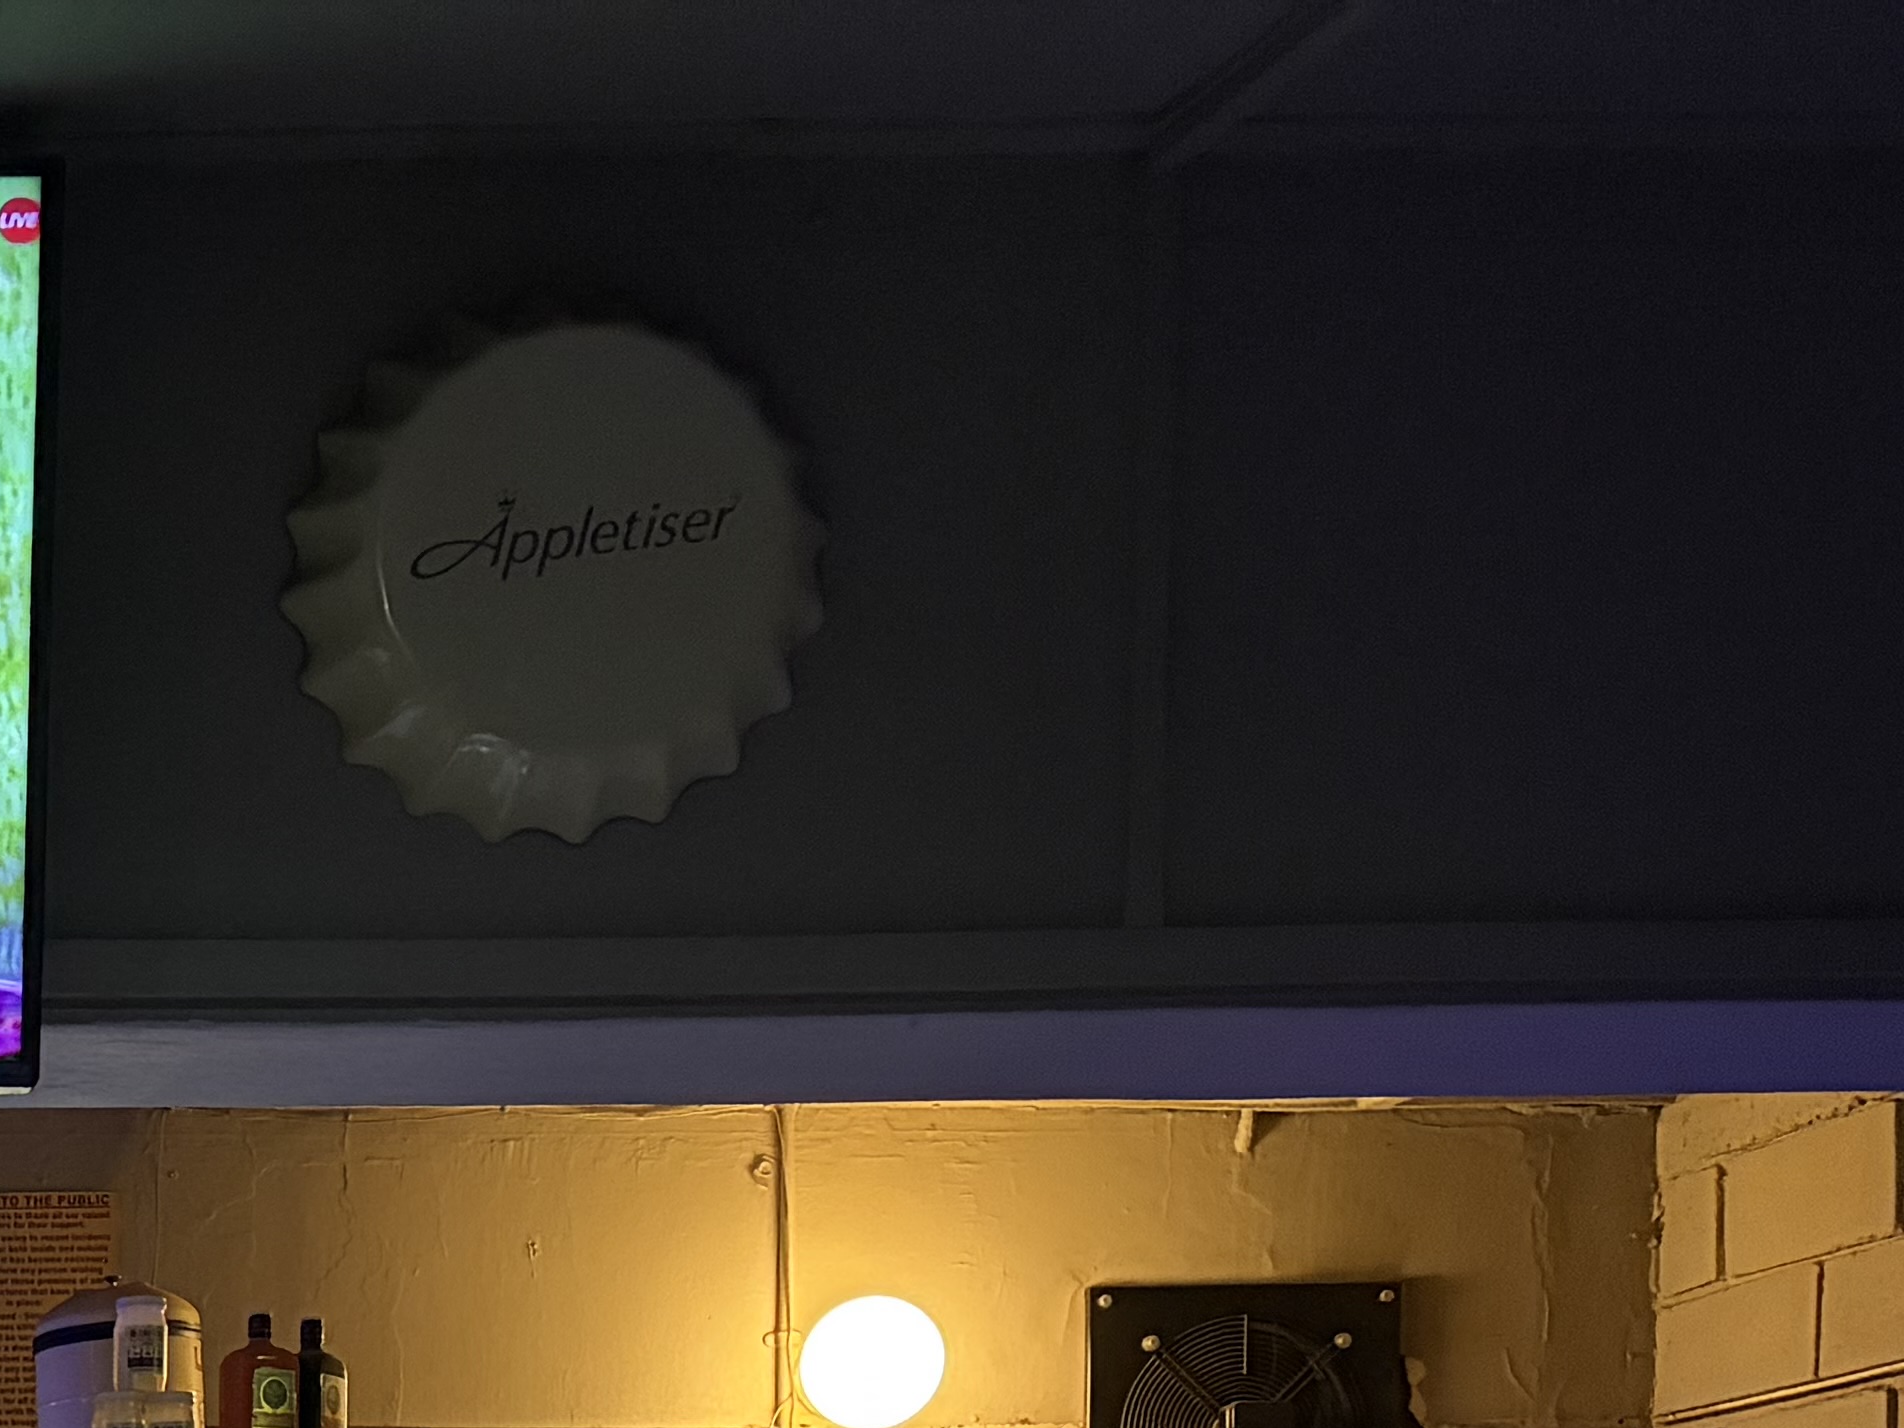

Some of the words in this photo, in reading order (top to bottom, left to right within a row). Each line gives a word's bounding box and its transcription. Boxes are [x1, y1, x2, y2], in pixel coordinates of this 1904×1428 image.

[410, 498, 735, 581] Appletiser
[0, 1195, 20, 1207] TO
[24, 1195, 53, 1207] THE
[56, 1194, 110, 1207] PUBLIC
